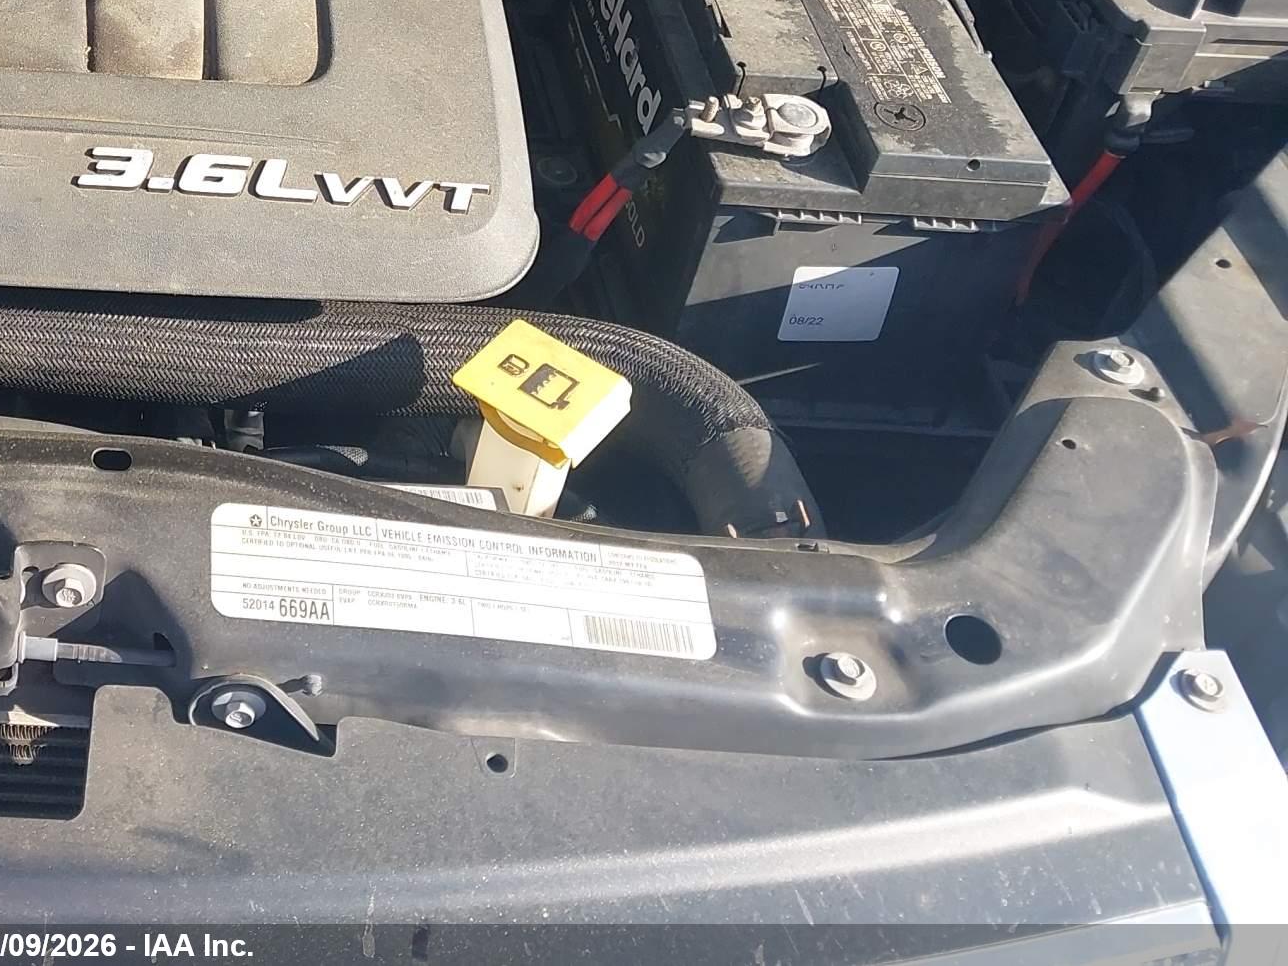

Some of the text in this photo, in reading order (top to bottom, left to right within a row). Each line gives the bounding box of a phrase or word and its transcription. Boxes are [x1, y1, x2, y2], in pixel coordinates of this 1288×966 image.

[70, 146, 492, 216] 3.6L VVT
[625, 199, 646, 248] OLD
[789, 316, 825, 326] 08/22
[270, 515, 373, 537] Chrysler Group LLC
[381, 529, 424, 543] VEHICLE
[427, 534, 475, 549] EMISSION
[479, 540, 524, 554] CONTROL
[528, 545, 597, 563] INFORMATION
[253, 583, 300, 594] ADJUSTMENTS
[242, 597, 331, 621] 52014 669AA
